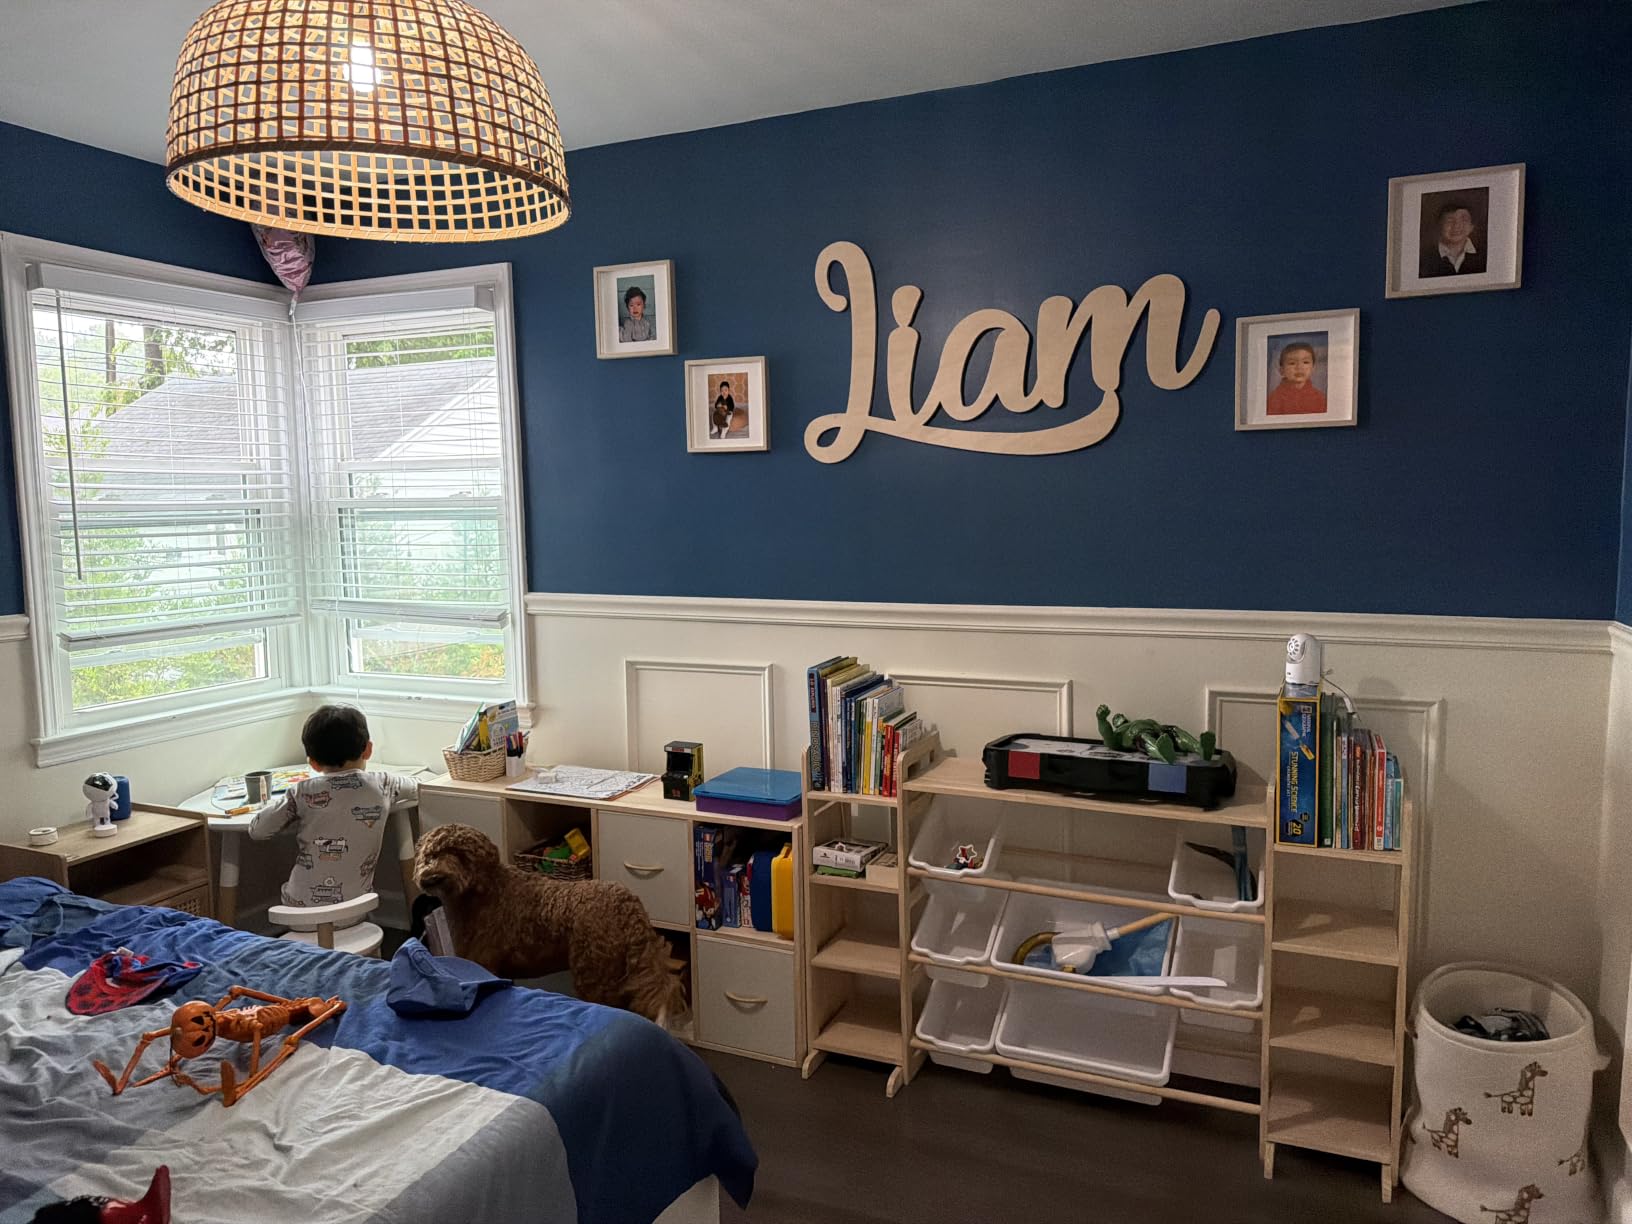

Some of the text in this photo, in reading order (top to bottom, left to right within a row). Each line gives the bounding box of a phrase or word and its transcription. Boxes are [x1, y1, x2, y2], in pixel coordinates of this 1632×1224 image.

[804, 241, 1221, 464] Liam
[810, 722, 821, 772] DINOSAURS
[1290, 751, 1298, 813] STUNNING SCIENCE
[1293, 822, 1302, 836] 20
